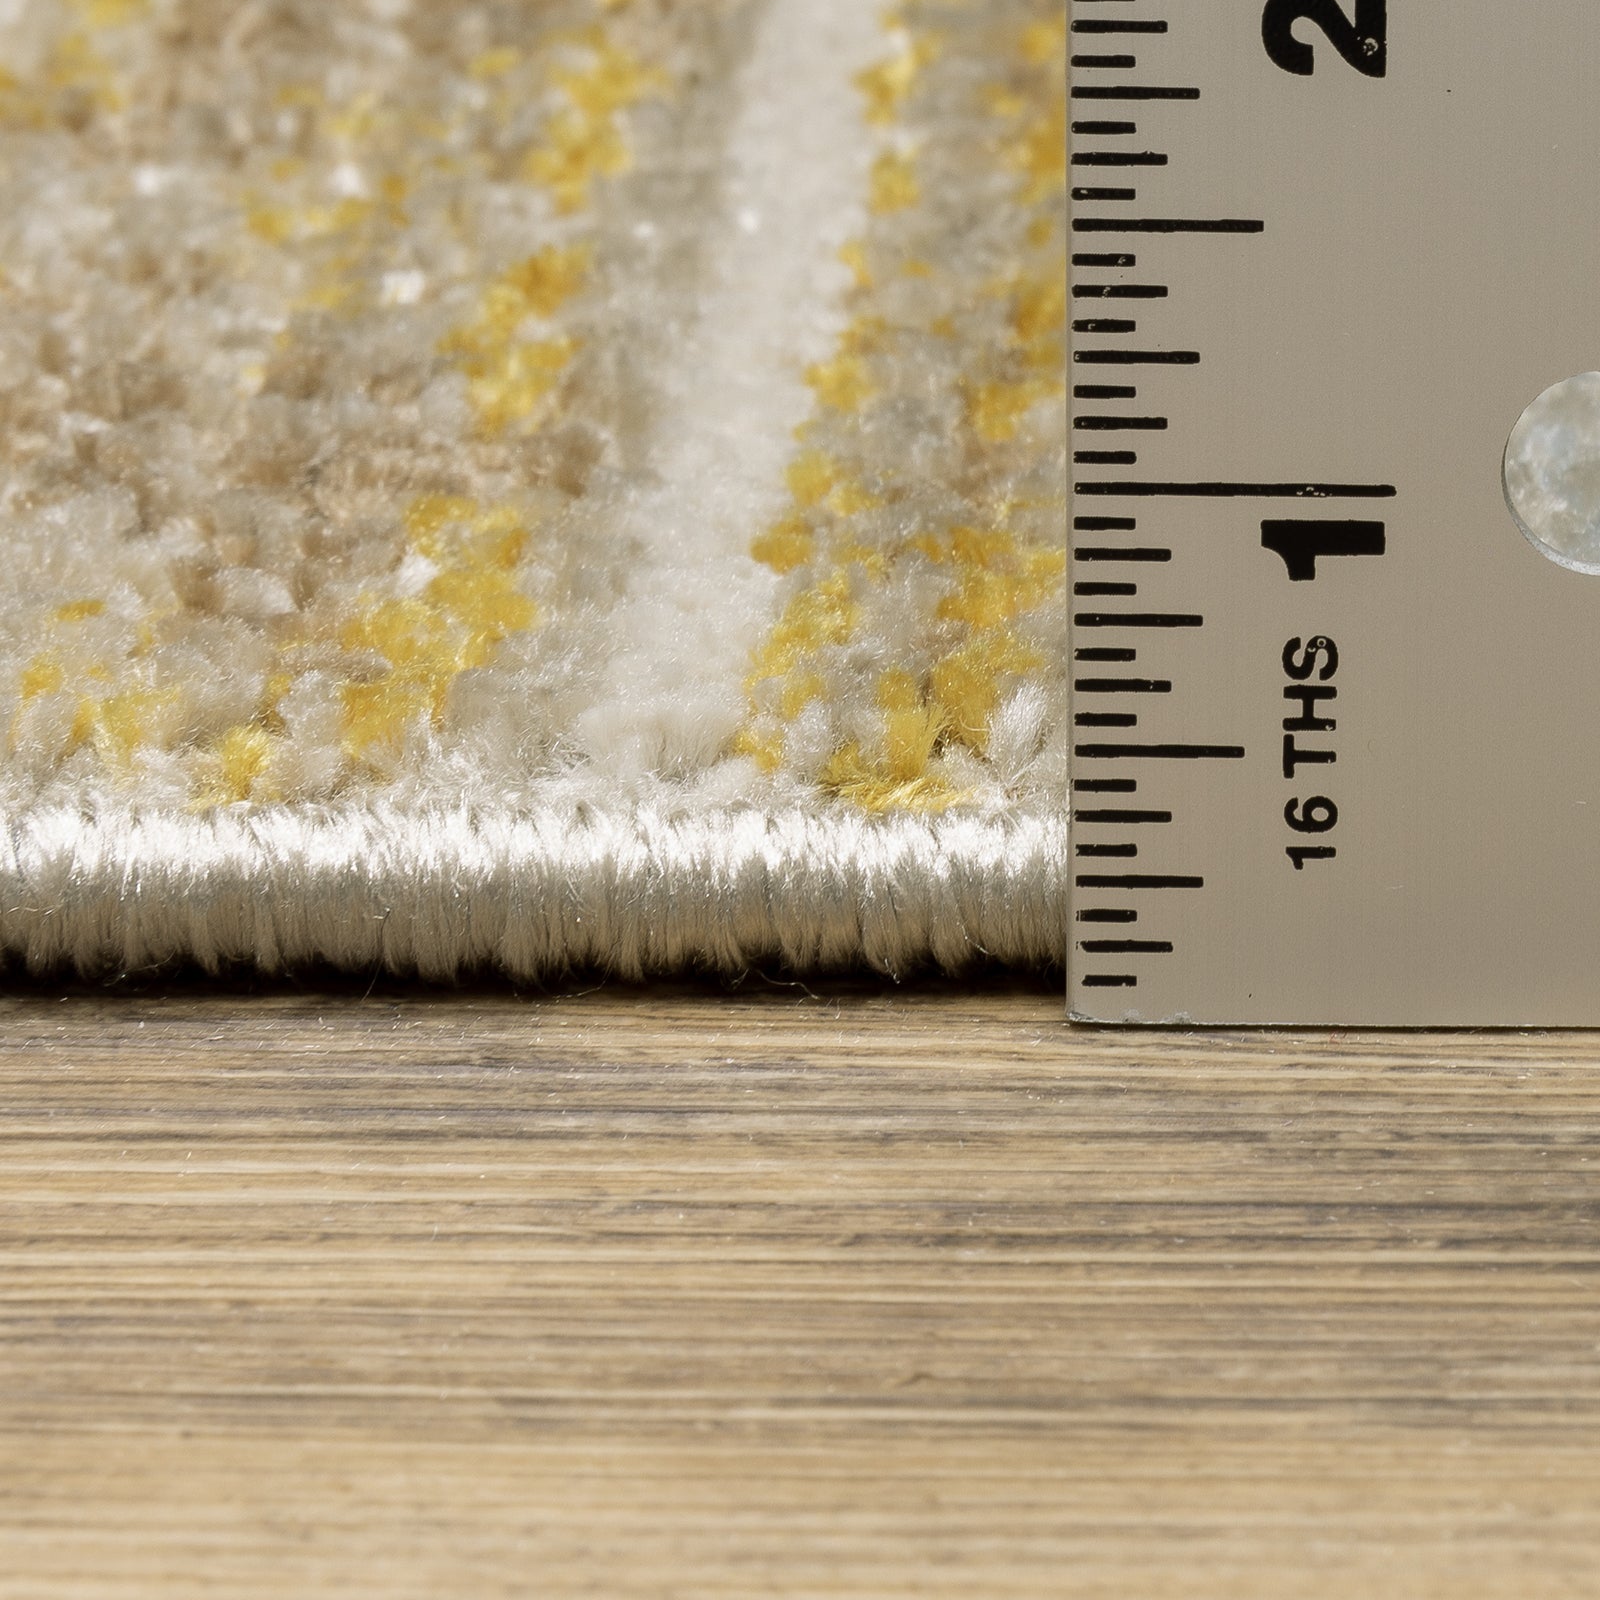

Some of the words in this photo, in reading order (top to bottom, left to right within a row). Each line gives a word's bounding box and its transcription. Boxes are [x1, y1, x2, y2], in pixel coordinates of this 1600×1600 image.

[1260, 518, 1386, 582] 1
[1282, 635, 1339, 779] THS
[1284, 796, 1338, 871] 16
